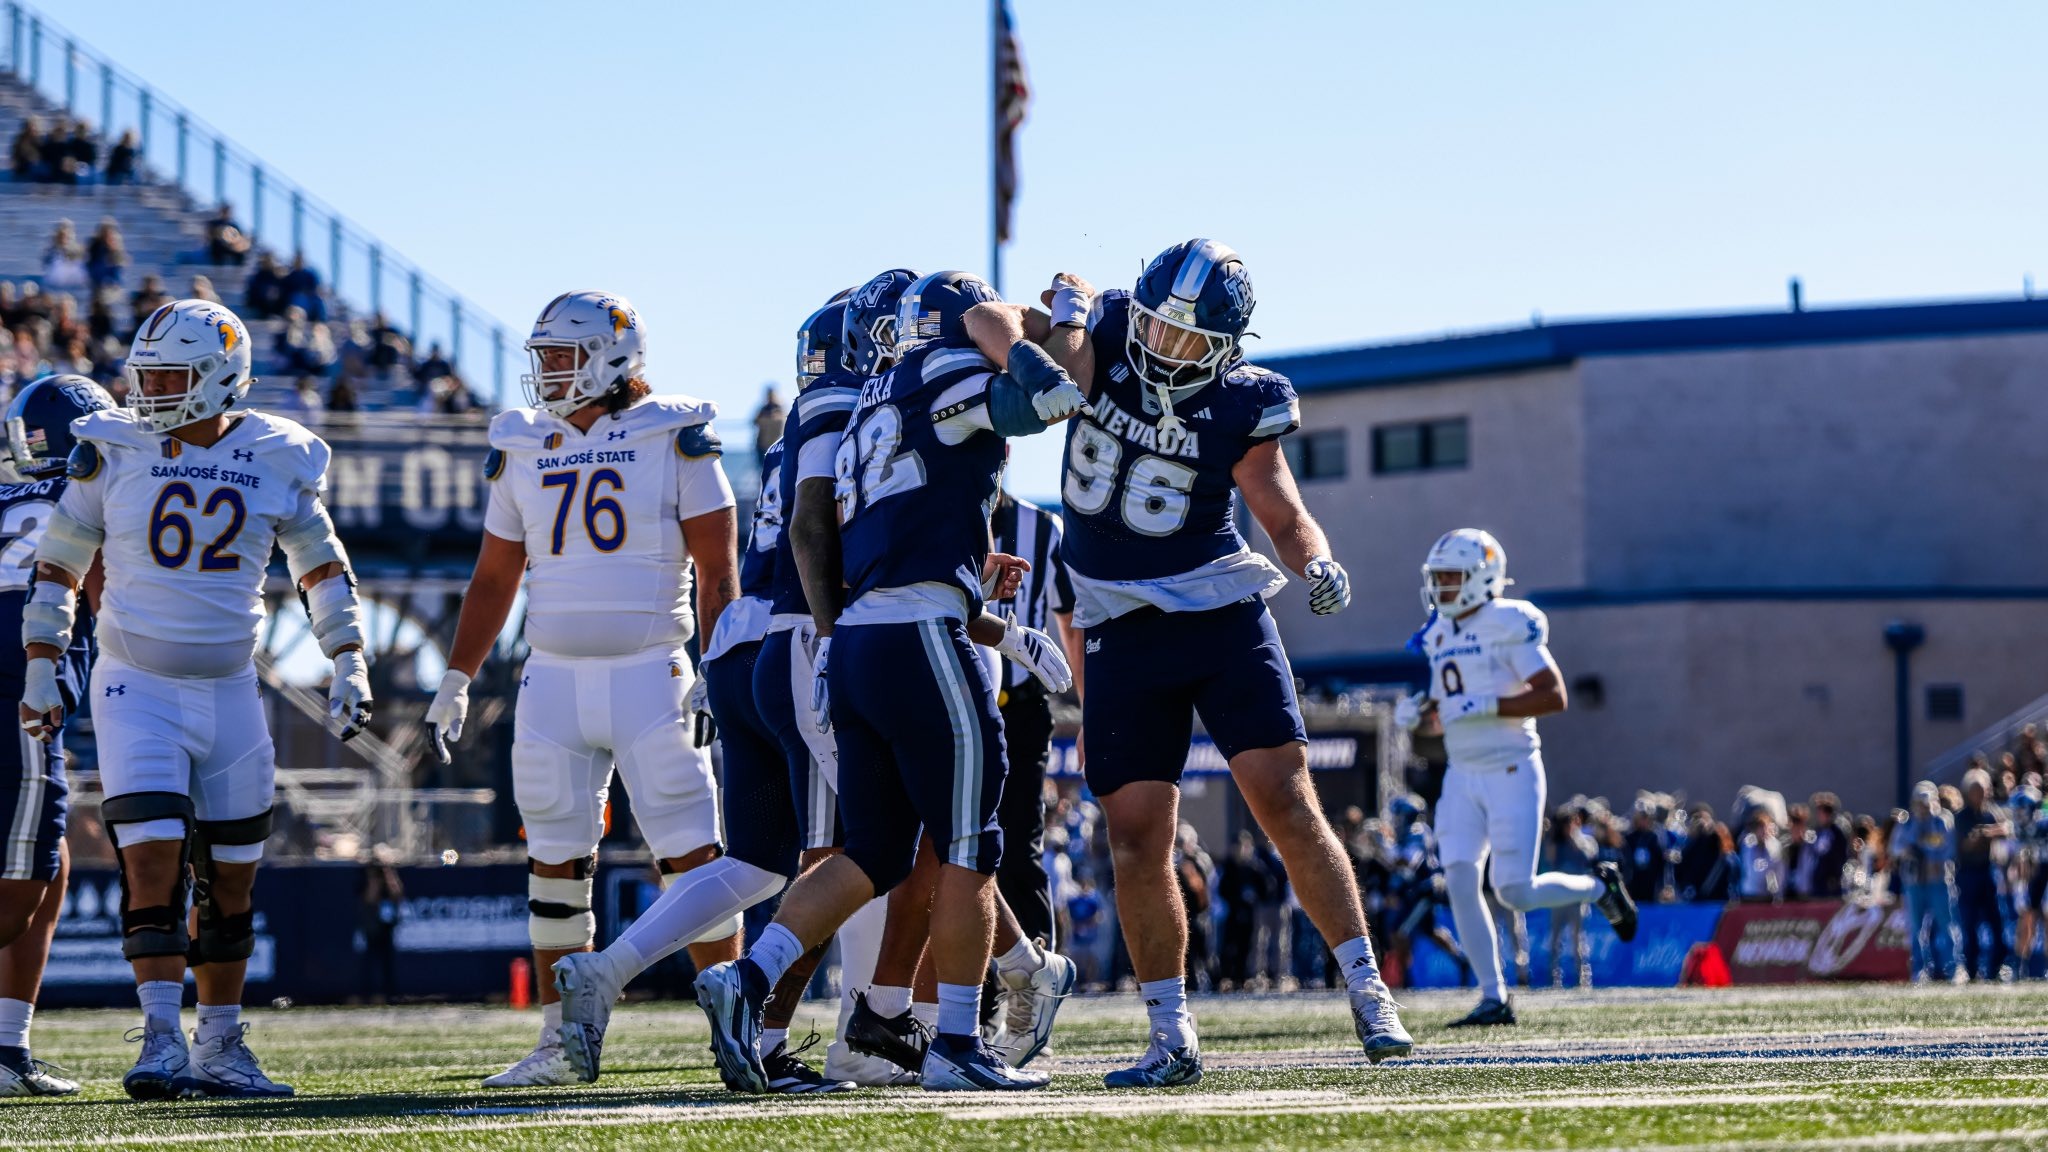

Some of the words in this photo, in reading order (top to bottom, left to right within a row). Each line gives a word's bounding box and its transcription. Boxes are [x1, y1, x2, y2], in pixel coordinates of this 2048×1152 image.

[1092, 391, 1200, 459] NEVADA
[151, 465, 179, 478] SAN
[179, 464, 218, 480] JOSÉ
[220, 470, 261, 489] STATE
[537, 457, 560, 470] SAN
[562, 449, 594, 466] JOSÉ
[596, 450, 636, 463] STATE
[1062, 418, 1199, 538] 96
[148, 480, 247, 572] 62
[542, 467, 628, 556] 76
[1442, 660, 1465, 698] 0
